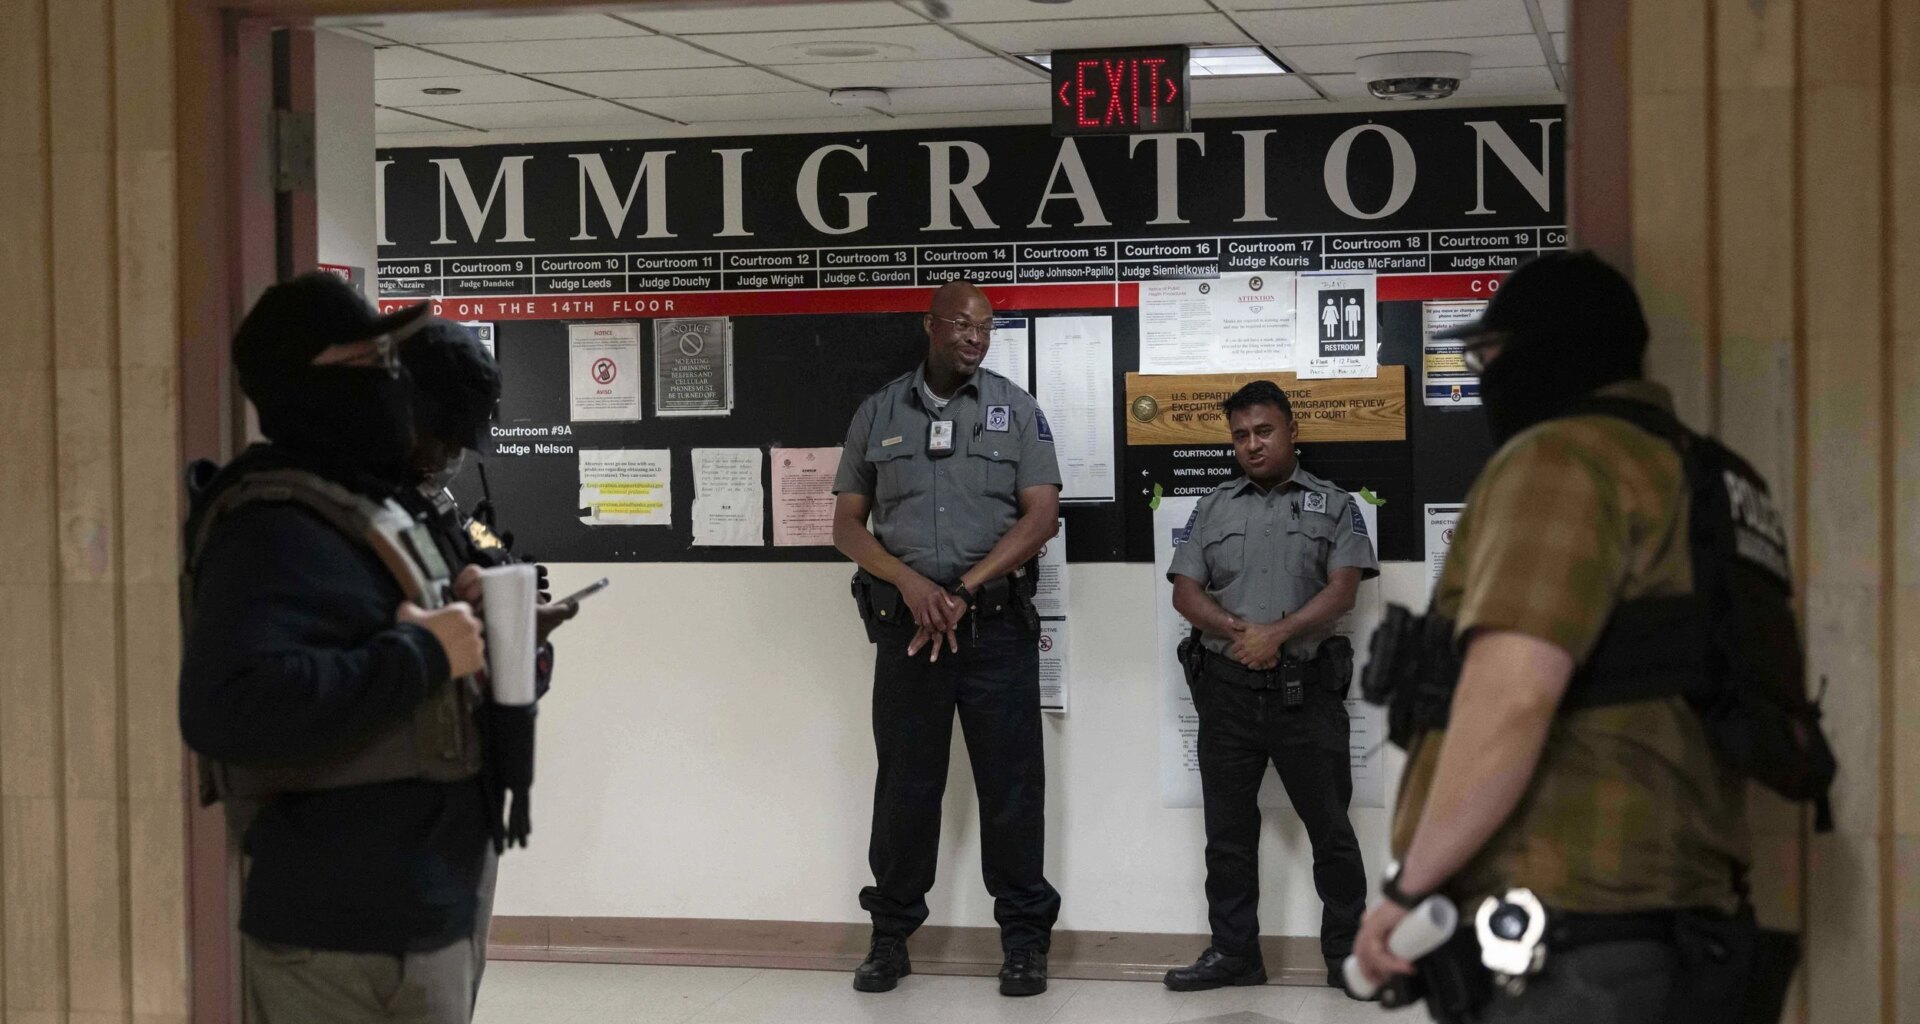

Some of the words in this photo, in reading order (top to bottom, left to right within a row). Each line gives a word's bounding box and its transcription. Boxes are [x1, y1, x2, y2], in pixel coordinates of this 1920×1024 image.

[1077, 58, 1166, 127] EXIT
[1332, 238, 1401, 250] Courtroom
[1407, 237, 1421, 248] 18
[1439, 235, 1509, 247] Courtroom
[1514, 233, 1529, 245] 19
[1024, 247, 1089, 259] Courtroom
[1093, 246, 1107, 257] 15
[1125, 245, 1192, 256] Courtroom
[1196, 243, 1210, 254] 16
[1228, 242, 1295, 254] Courtroom
[1300, 240, 1314, 252] 17
[730, 255, 793, 267] Courtroom
[798, 254, 810, 265] 12
[826, 252, 889, 264] Courtroom
[894, 251, 907, 262] 13
[924, 250, 988, 262] Courtroom
[992, 249, 1006, 260] 14
[1228, 255, 1266, 269] Judge
[1269, 255, 1310, 267] Kouris
[1450, 256, 1486, 268] Judge
[1488, 255, 1518, 266] Khan
[378, 264, 420, 275] urtroom
[424, 263, 432, 274] 8
[452, 261, 511, 273] Courtroom
[515, 261, 524, 271] 9
[541, 259, 601, 271] Courtroom
[606, 258, 619, 269] 10
[637, 257, 698, 269] Courtroom
[702, 256, 713, 267] 11
[1330, 258, 1365, 270] Judge
[1368, 257, 1426, 269] McFarland
[824, 272, 856, 284] Judge
[858, 271, 869, 283] C.
[872, 270, 911, 282] Gordon
[926, 269, 961, 281] Judge
[963, 268, 1013, 281] Zagzoug
[1018, 267, 1045, 279] Judge
[1046, 266, 1114, 279] Johnson-Papillo
[1122, 265, 1150, 278] Judge
[1152, 263, 1219, 276] Siemietkowski
[379, 281, 396, 290] udge
[398, 281, 426, 289] Nazaire
[459, 280, 481, 289] Judge
[482, 279, 515, 288] Dandelet
[549, 278, 580, 290] Judge
[582, 278, 612, 288] Leeds
[639, 277, 670, 289] Judge
[672, 276, 711, 288] Douchy
[737, 275, 768, 287] Judge
[770, 274, 804, 287] Wright
[459, 304, 484, 315] ON
[498, 303, 536, 314] THE
[551, 301, 594, 313] 14TH
[613, 300, 674, 312] FLOOR
[672, 322, 711, 337] NOTICE
[1324, 343, 1360, 352] RESTROOM
[671, 371, 697, 379] BEEPERS
[1171, 392, 1189, 401] U.S.
[1192, 391, 1237, 401] DEPARTM
[1285, 390, 1312, 399] STICE
[1171, 402, 1222, 412] EXECUTIVE
[1290, 399, 1346, 409] MMIGRATION
[1350, 398, 1386, 408] REVIEW
[1172, 413, 1195, 422] NEW
[1197, 413, 1222, 421] YORK
[1314, 410, 1347, 419] COURT
[491, 426, 548, 437] Courtroom
[551, 425, 572, 436] #9A
[496, 443, 530, 456] Judge
[535, 443, 573, 454] Nelson
[1173, 449, 1224, 458] COURTROOM
[1173, 468, 1205, 477] WAITING
[1207, 468, 1232, 476] ROOM
